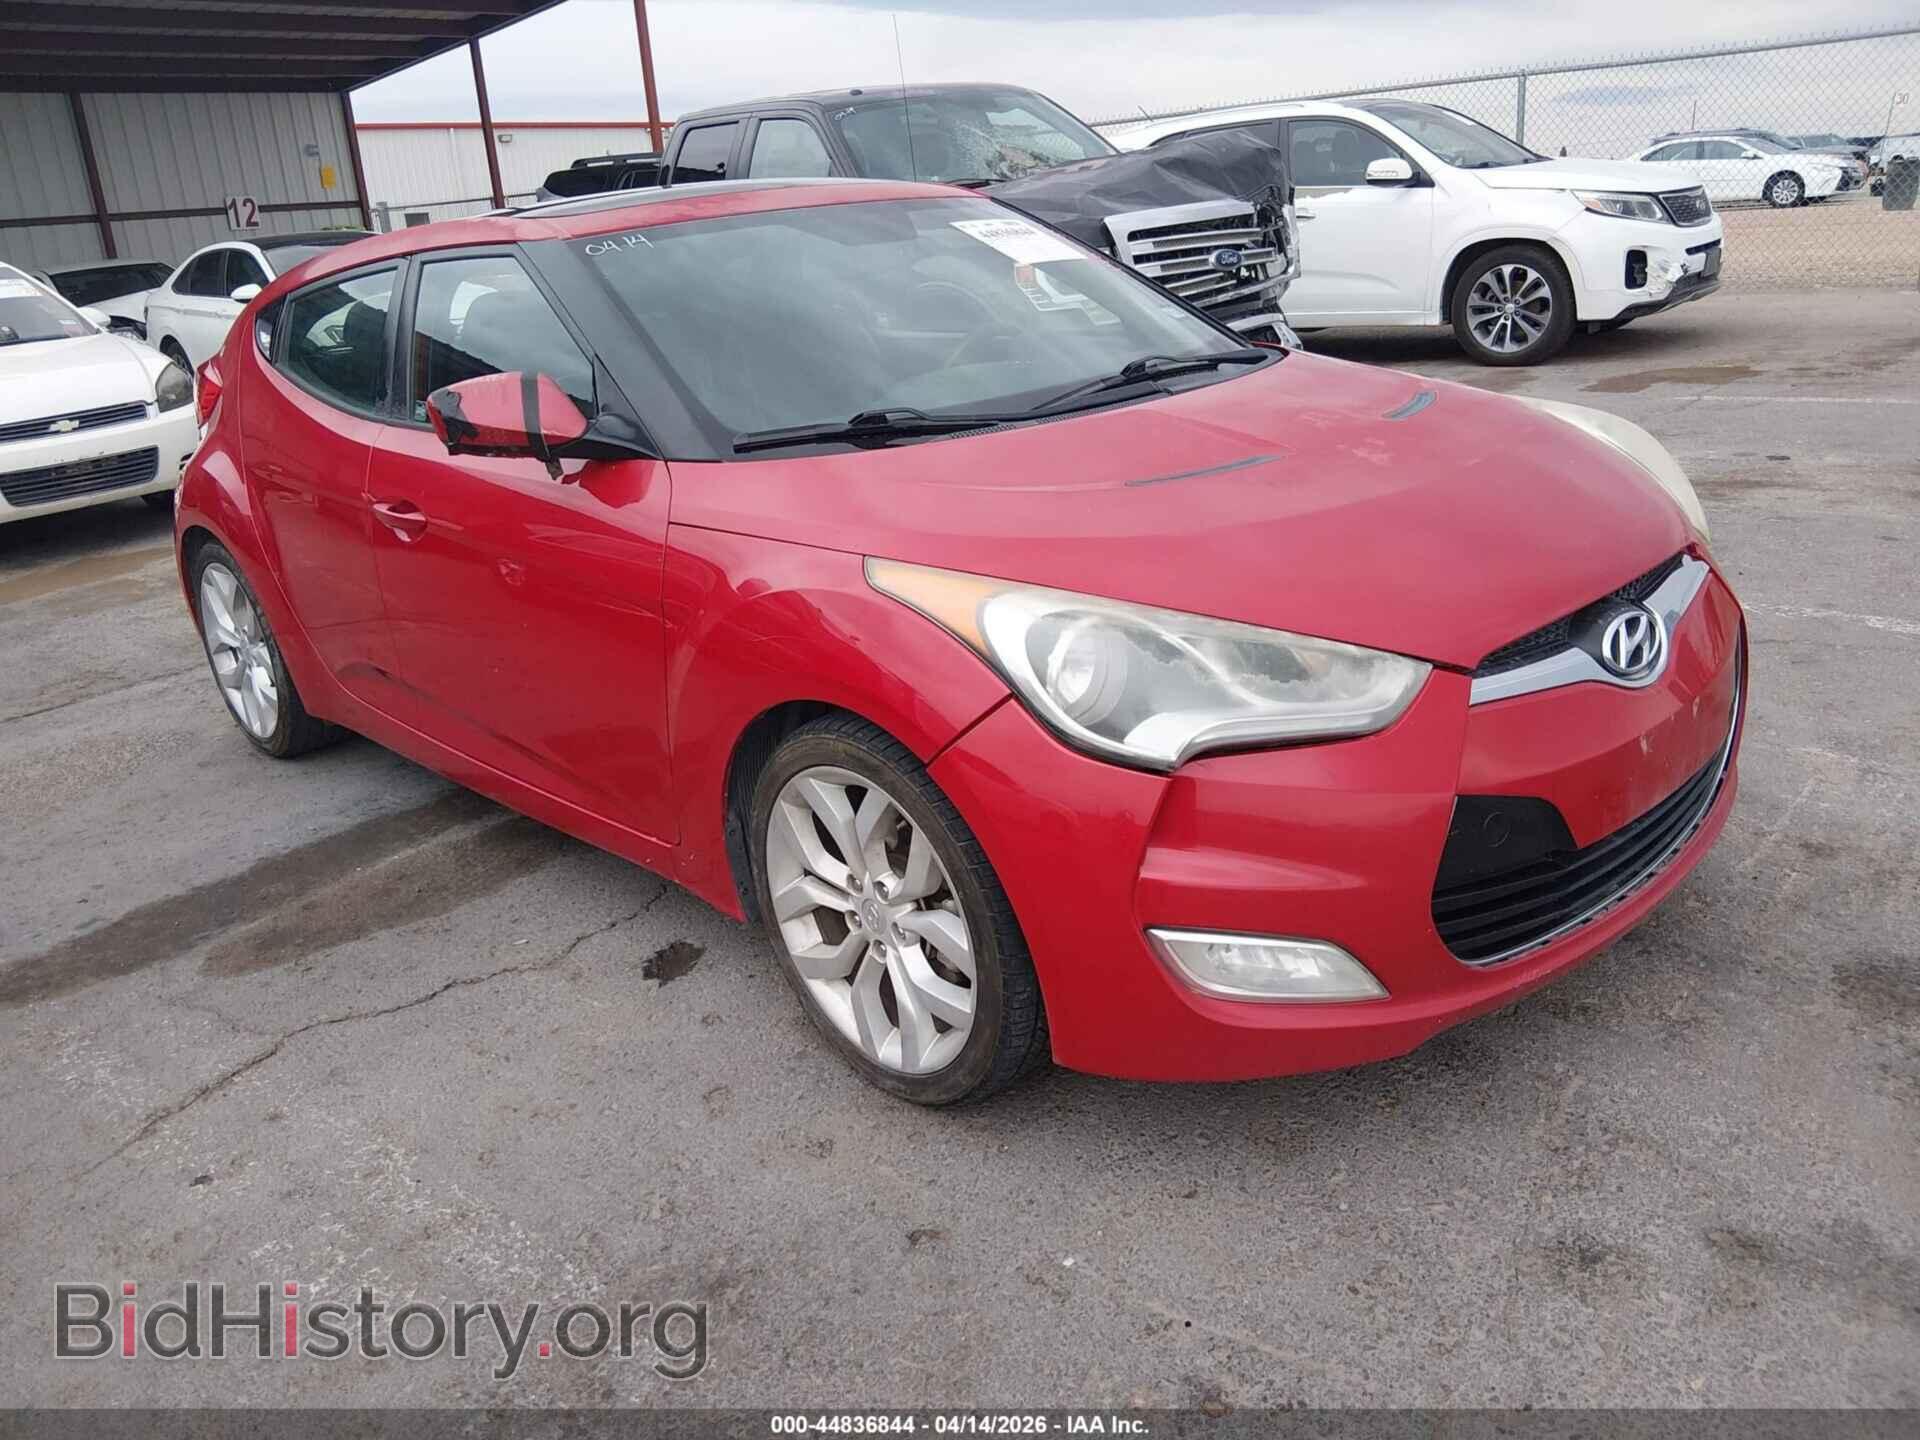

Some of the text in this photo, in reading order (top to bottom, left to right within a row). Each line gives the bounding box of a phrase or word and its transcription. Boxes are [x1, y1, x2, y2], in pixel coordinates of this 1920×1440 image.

[228, 197, 259, 228] 12
[585, 239, 623, 256] 04
[1220, 251, 1240, 265] Ford
